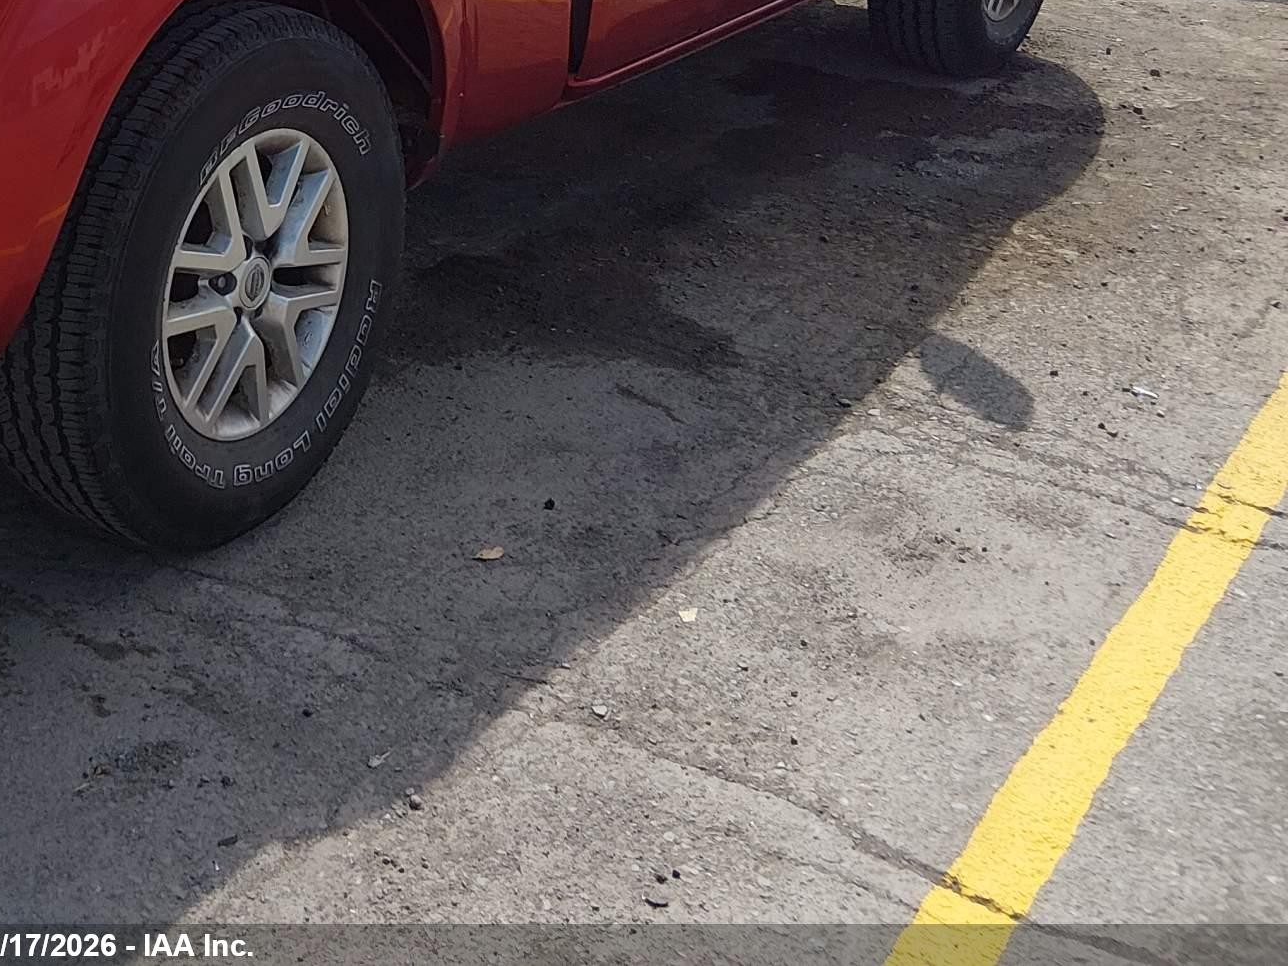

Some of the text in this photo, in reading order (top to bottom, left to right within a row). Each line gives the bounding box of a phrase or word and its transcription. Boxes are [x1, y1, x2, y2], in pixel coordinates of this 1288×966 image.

[314, 279, 383, 432] Radial
[164, 424, 226, 489] Trail
[233, 430, 312, 486] Long
